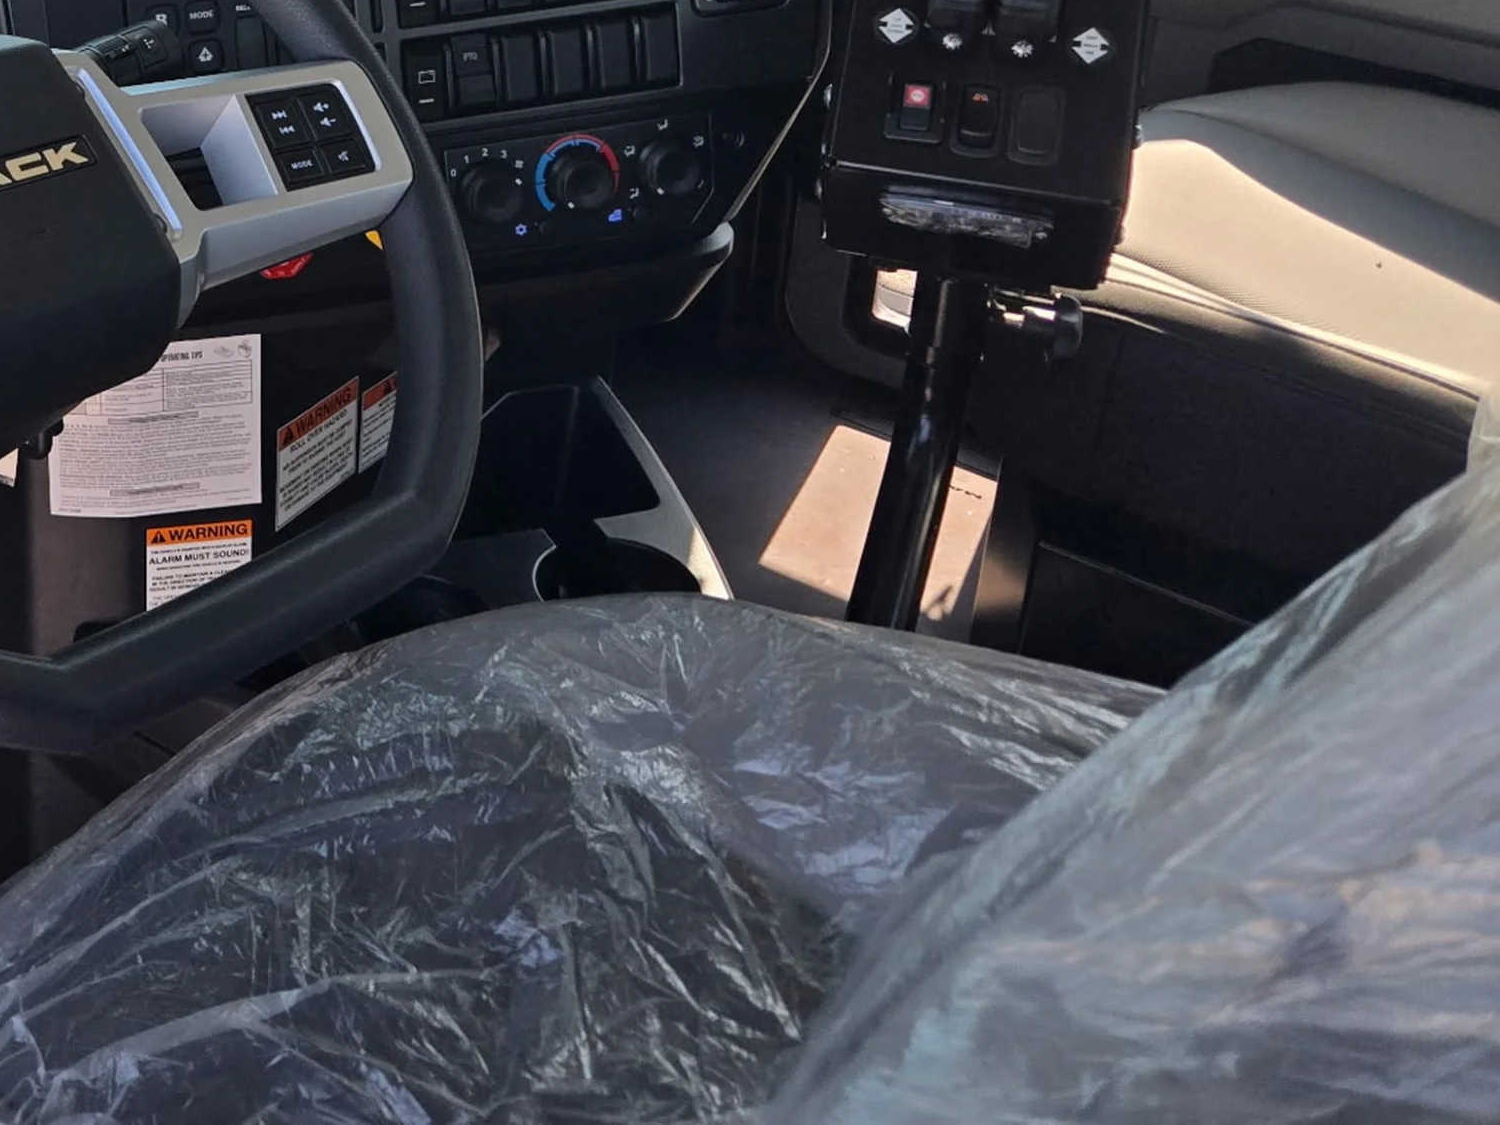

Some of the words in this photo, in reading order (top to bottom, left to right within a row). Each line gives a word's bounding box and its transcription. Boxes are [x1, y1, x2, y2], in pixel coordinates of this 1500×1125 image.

[189, 10, 215, 21] MODE
[481, 147, 489, 157] 2
[500, 149, 507, 159] 3
[464, 155, 469, 164] 1
[450, 168, 457, 177] 0
[295, 387, 351, 437] WARNING
[168, 523, 248, 541] WARNING
[149, 554, 182, 565] ALARM
[184, 552, 211, 562] MUST
